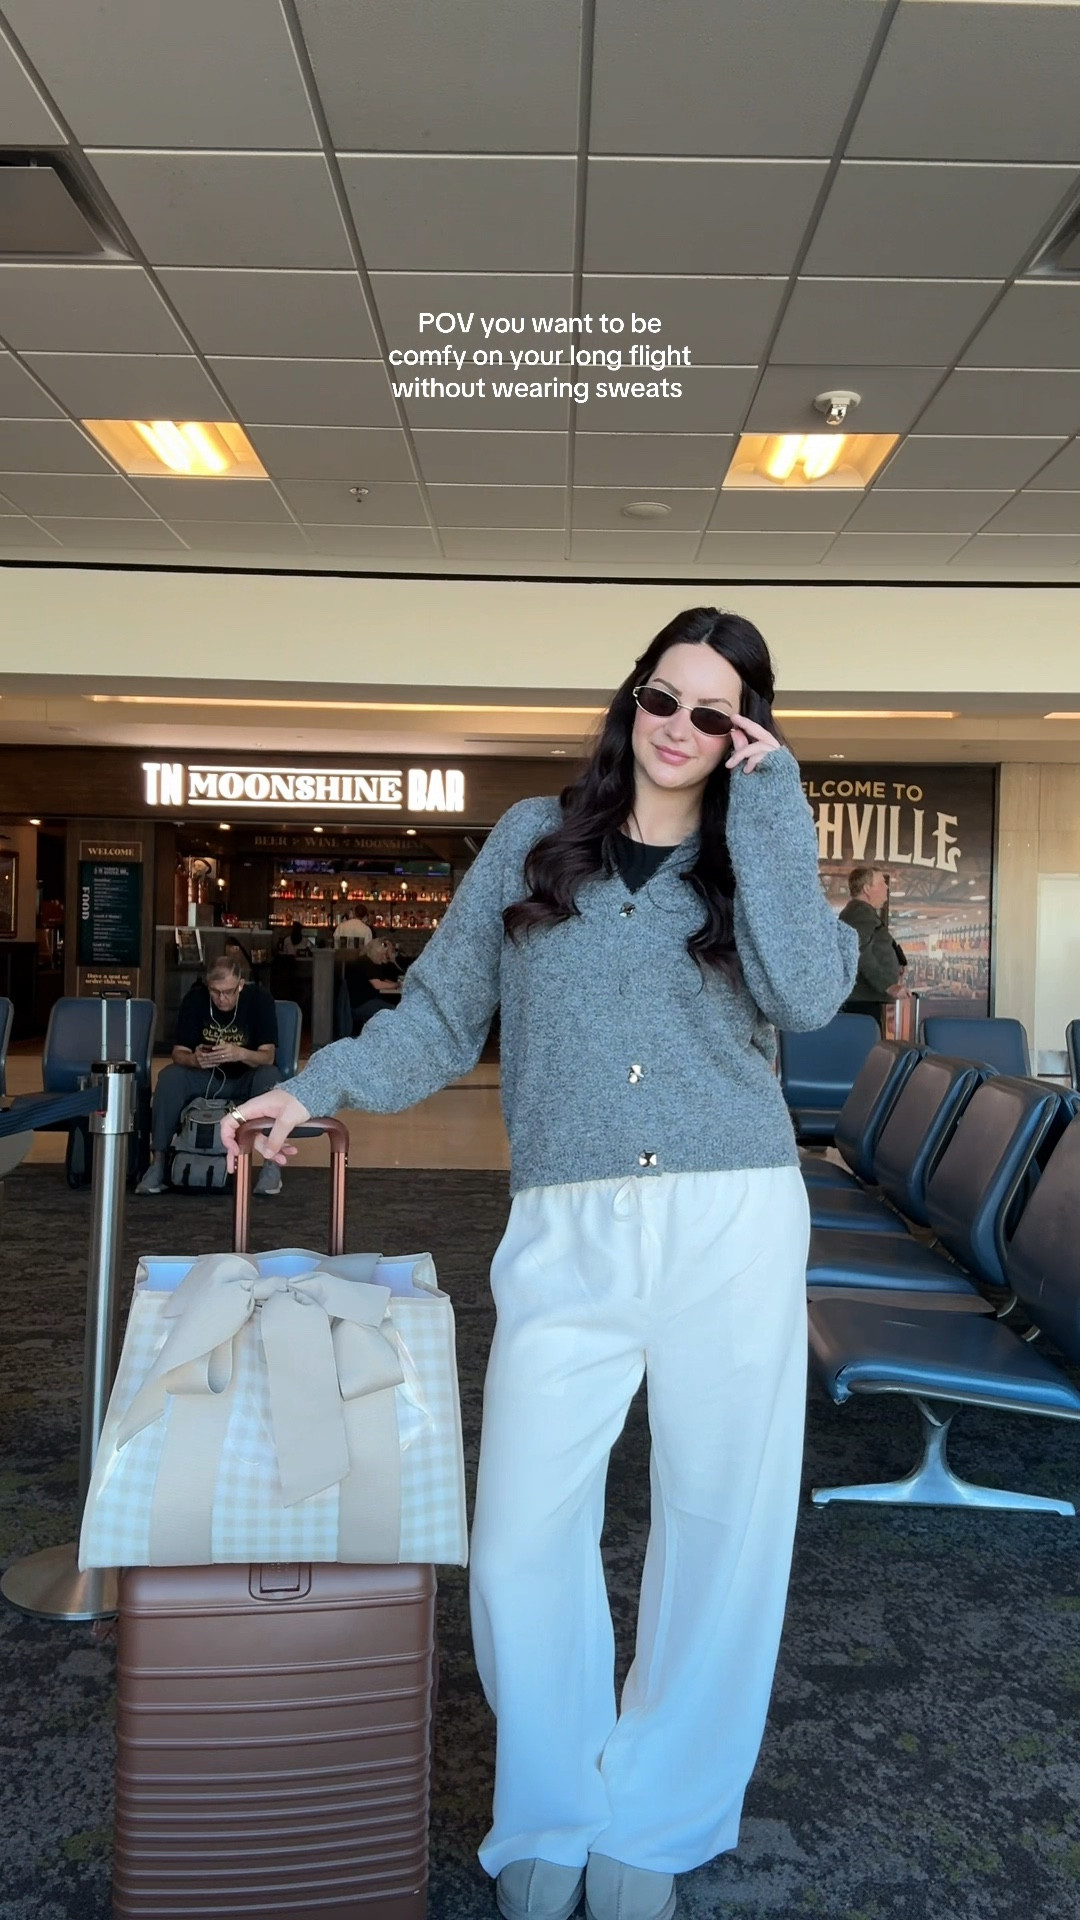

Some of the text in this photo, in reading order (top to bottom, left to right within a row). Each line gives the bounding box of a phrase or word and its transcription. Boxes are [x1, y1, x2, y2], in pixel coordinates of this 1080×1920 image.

[142, 762, 465, 812] TN MOONSHINE BAR
[801, 780, 923, 802] LCOME TO
[88, 847, 135, 856] WELCOME
[254, 835, 288, 846] BEER
[306, 836, 338, 847] WINE
[814, 802, 962, 873] HVILLE
[82, 886, 90, 920] FOOD
